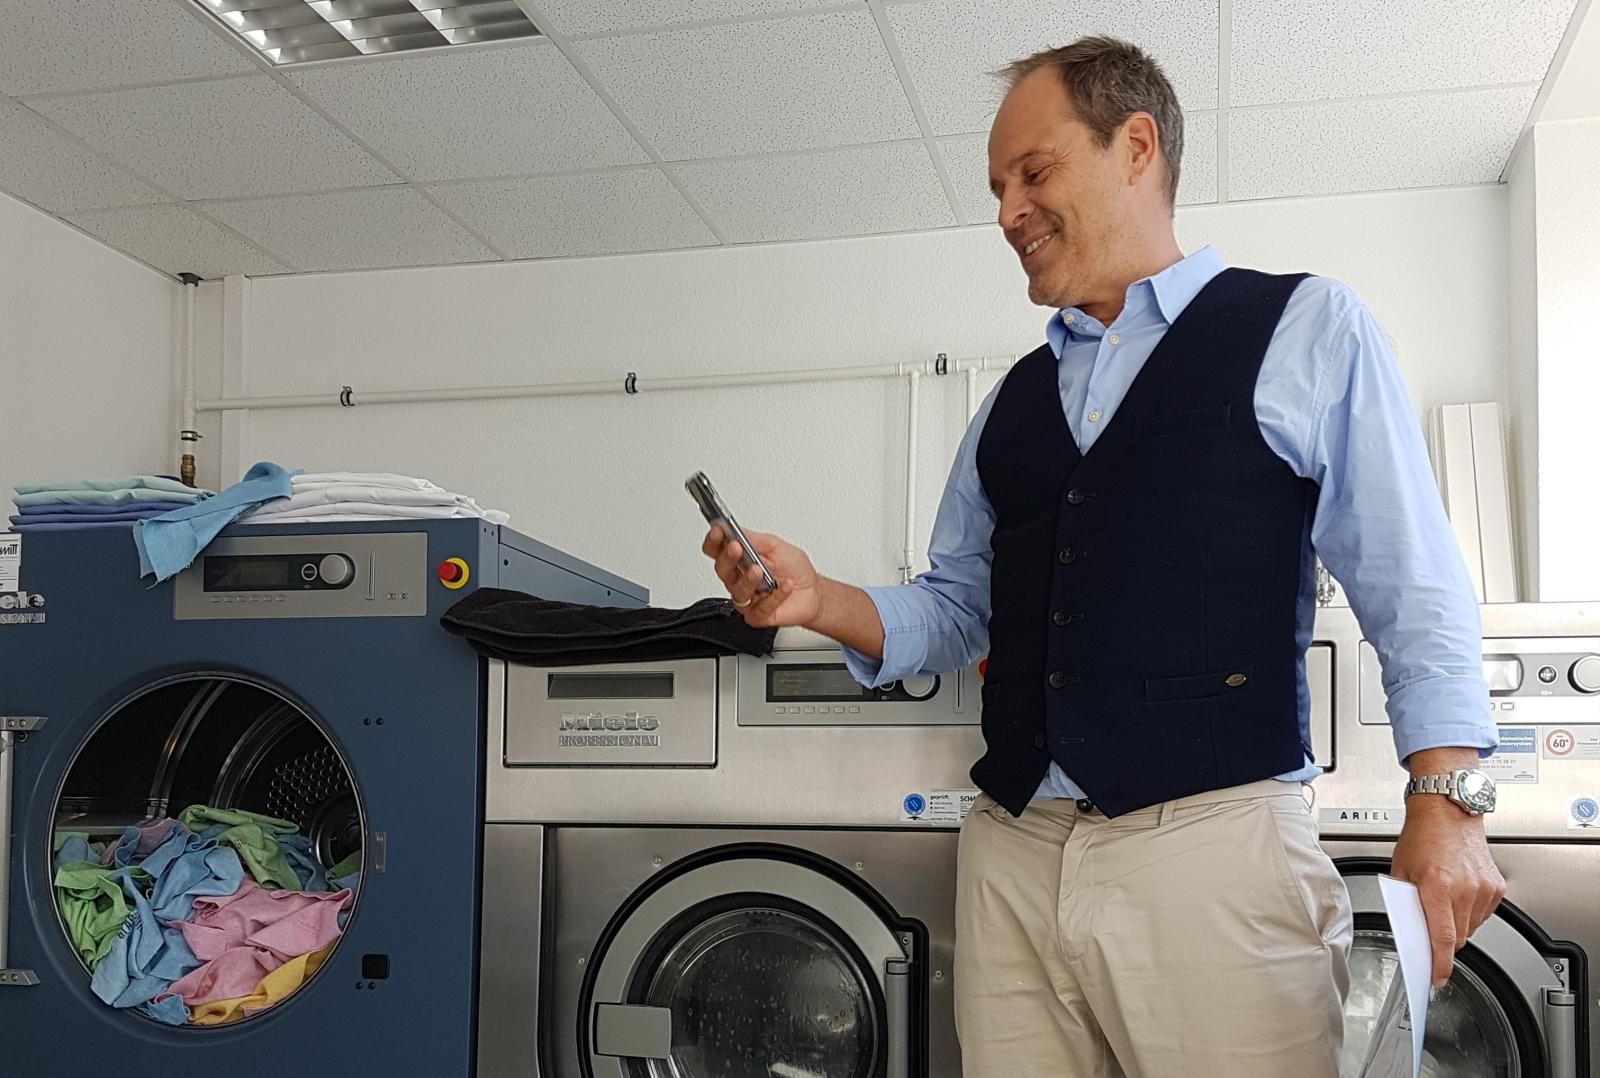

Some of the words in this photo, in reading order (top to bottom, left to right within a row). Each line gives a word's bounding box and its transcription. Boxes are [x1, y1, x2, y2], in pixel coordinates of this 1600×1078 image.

[559, 711, 661, 731] Miele
[559, 735, 661, 747] PROFESSIONAL
[1340, 811, 1389, 820] ARIEL
